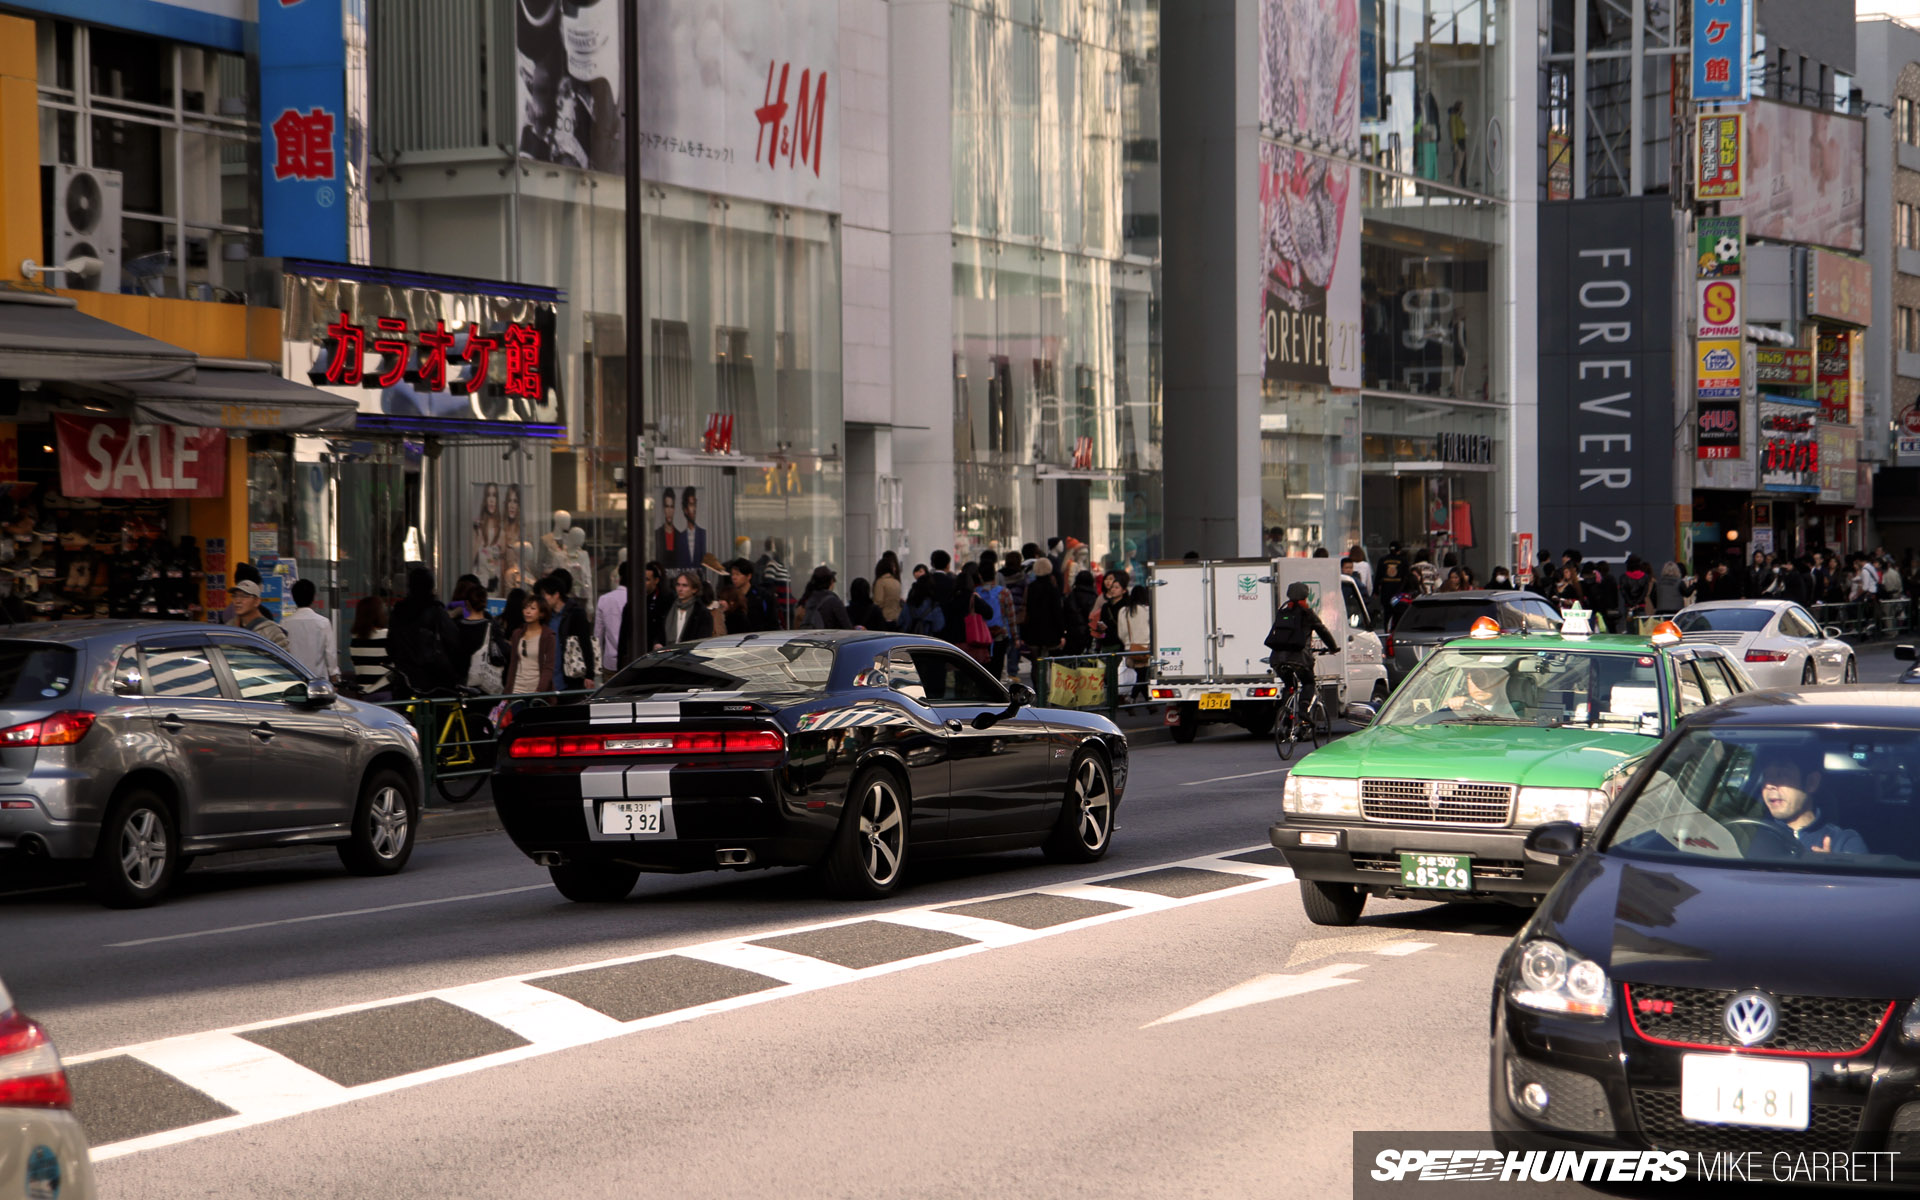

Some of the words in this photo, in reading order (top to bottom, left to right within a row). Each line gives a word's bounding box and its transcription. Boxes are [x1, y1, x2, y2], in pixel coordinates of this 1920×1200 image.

[1704, 0, 1731, 83] ケ館
[755, 59, 827, 179] H&M
[1703, 281, 1735, 325] S
[1265, 309, 1334, 370] OREVER
[1699, 326, 1739, 337] SPINNS
[326, 311, 543, 400] カラオケ館
[1579, 248, 1632, 490] FOREVER
[1699, 410, 1737, 432] HUB
[84, 422, 200, 491] SALE
[1707, 448, 1732, 458] B1F
[634, 804, 647, 812] 331
[1416, 867, 1468, 888] 85-69
[1437, 857, 1456, 868] 500
